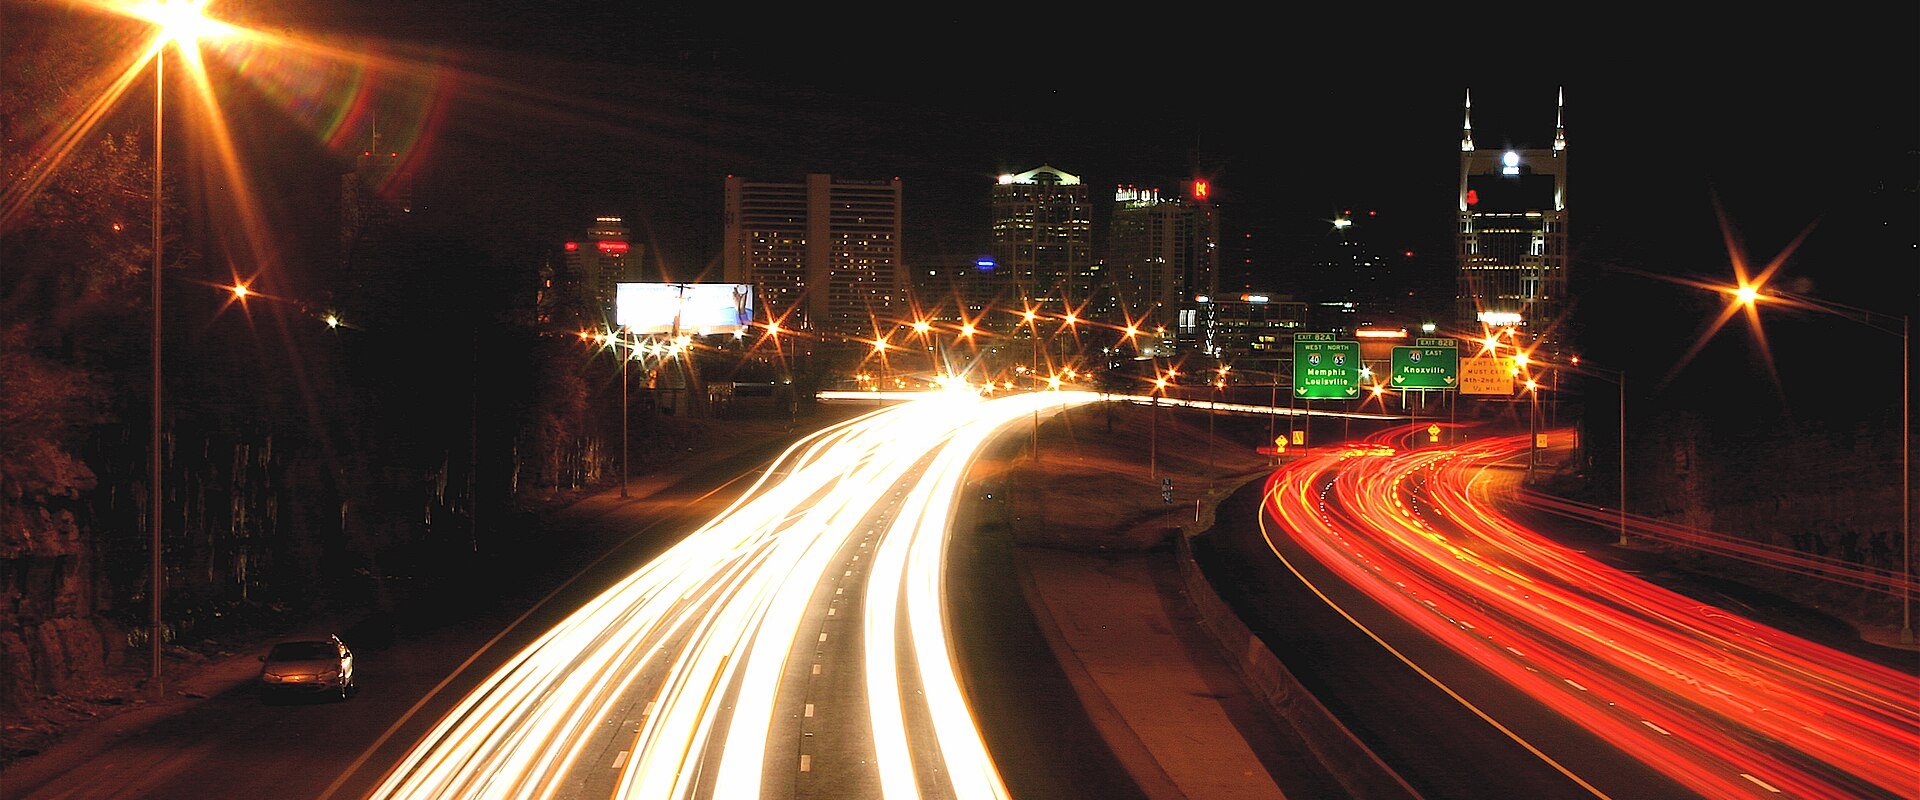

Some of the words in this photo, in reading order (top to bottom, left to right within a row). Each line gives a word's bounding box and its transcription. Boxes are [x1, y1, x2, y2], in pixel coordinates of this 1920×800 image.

[1309, 355, 1320, 364] 40
[1334, 356, 1344, 364] 65
[1410, 353, 1420, 361] 40
[1307, 368, 1346, 377] Memphis
